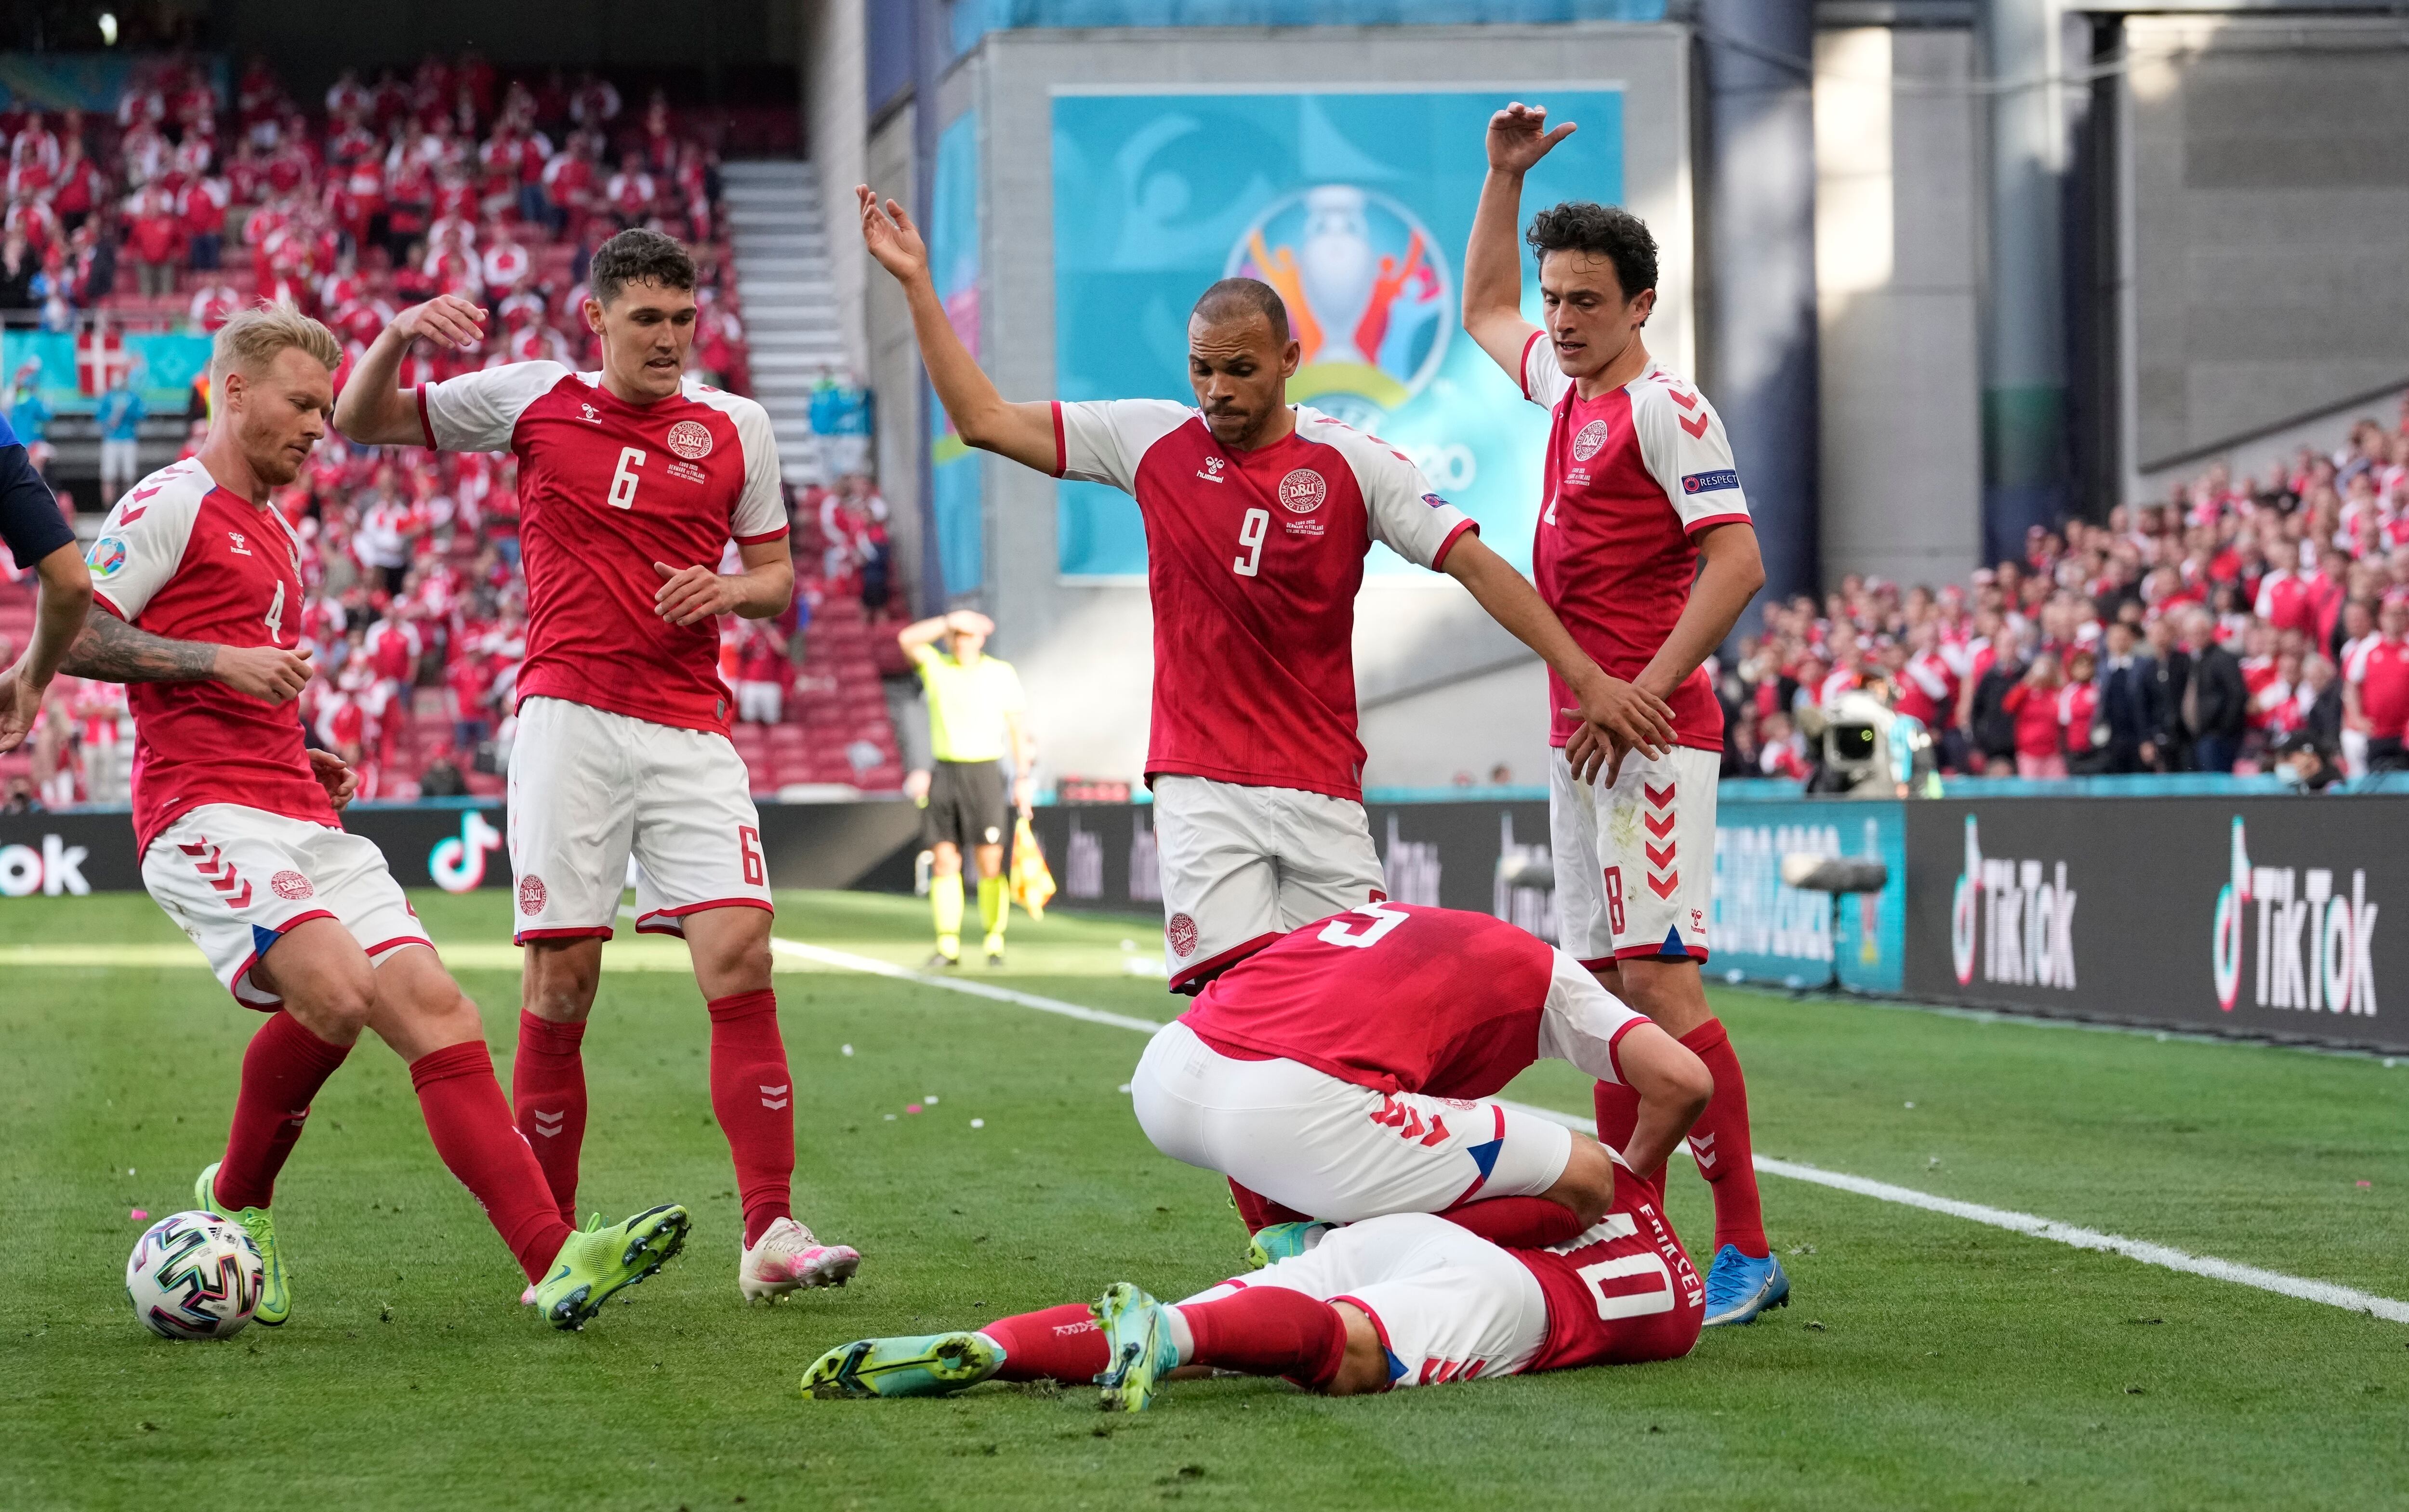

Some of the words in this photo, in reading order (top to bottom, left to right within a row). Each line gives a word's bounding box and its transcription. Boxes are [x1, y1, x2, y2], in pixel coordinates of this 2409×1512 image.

[670, 430, 680, 452] DANSK
[677, 434, 702, 447] DBU
[1582, 434, 1601, 446] DBU
[607, 446, 646, 510] 6
[668, 464, 686, 473] DENMARK
[690, 470, 705, 479] FINLAND
[687, 475, 704, 484] COPENHAGEN
[1196, 470, 1224, 483] hummel
[1700, 475, 1736, 487] RESPECT
[1282, 484, 1294, 508] DANSK
[1289, 483, 1316, 497] DBU
[1233, 507, 1269, 577] 9
[265, 579, 285, 644] 4
[739, 825, 763, 887] 6
[279, 879, 306, 892] DBU
[525, 889, 541, 901] DBU
[1604, 866, 1625, 935] 8
[1317, 901, 1410, 948] 5
[1690, 924, 1706, 934] hummel
[1983, 859, 2077, 991] TikTok
[1176, 926, 1193, 944] DBU
[2252, 866, 2379, 1017] TikTok
[1543, 1212, 1675, 1321] 10
